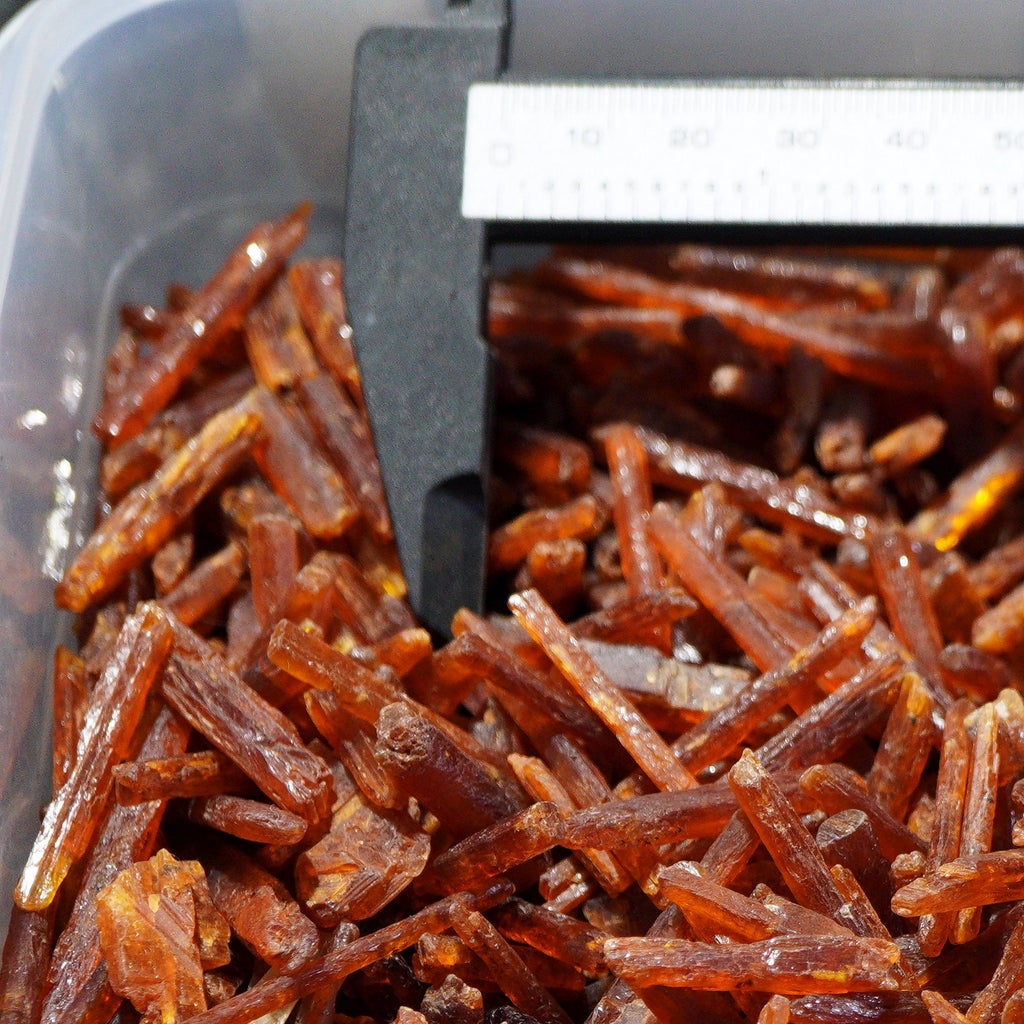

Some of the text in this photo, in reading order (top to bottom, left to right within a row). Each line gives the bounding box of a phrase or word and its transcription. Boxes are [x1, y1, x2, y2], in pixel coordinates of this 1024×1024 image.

[565, 127, 602, 149] 10
[668, 126, 712, 150] 20
[776, 127, 820, 150] 30
[884, 128, 929, 151] 40
